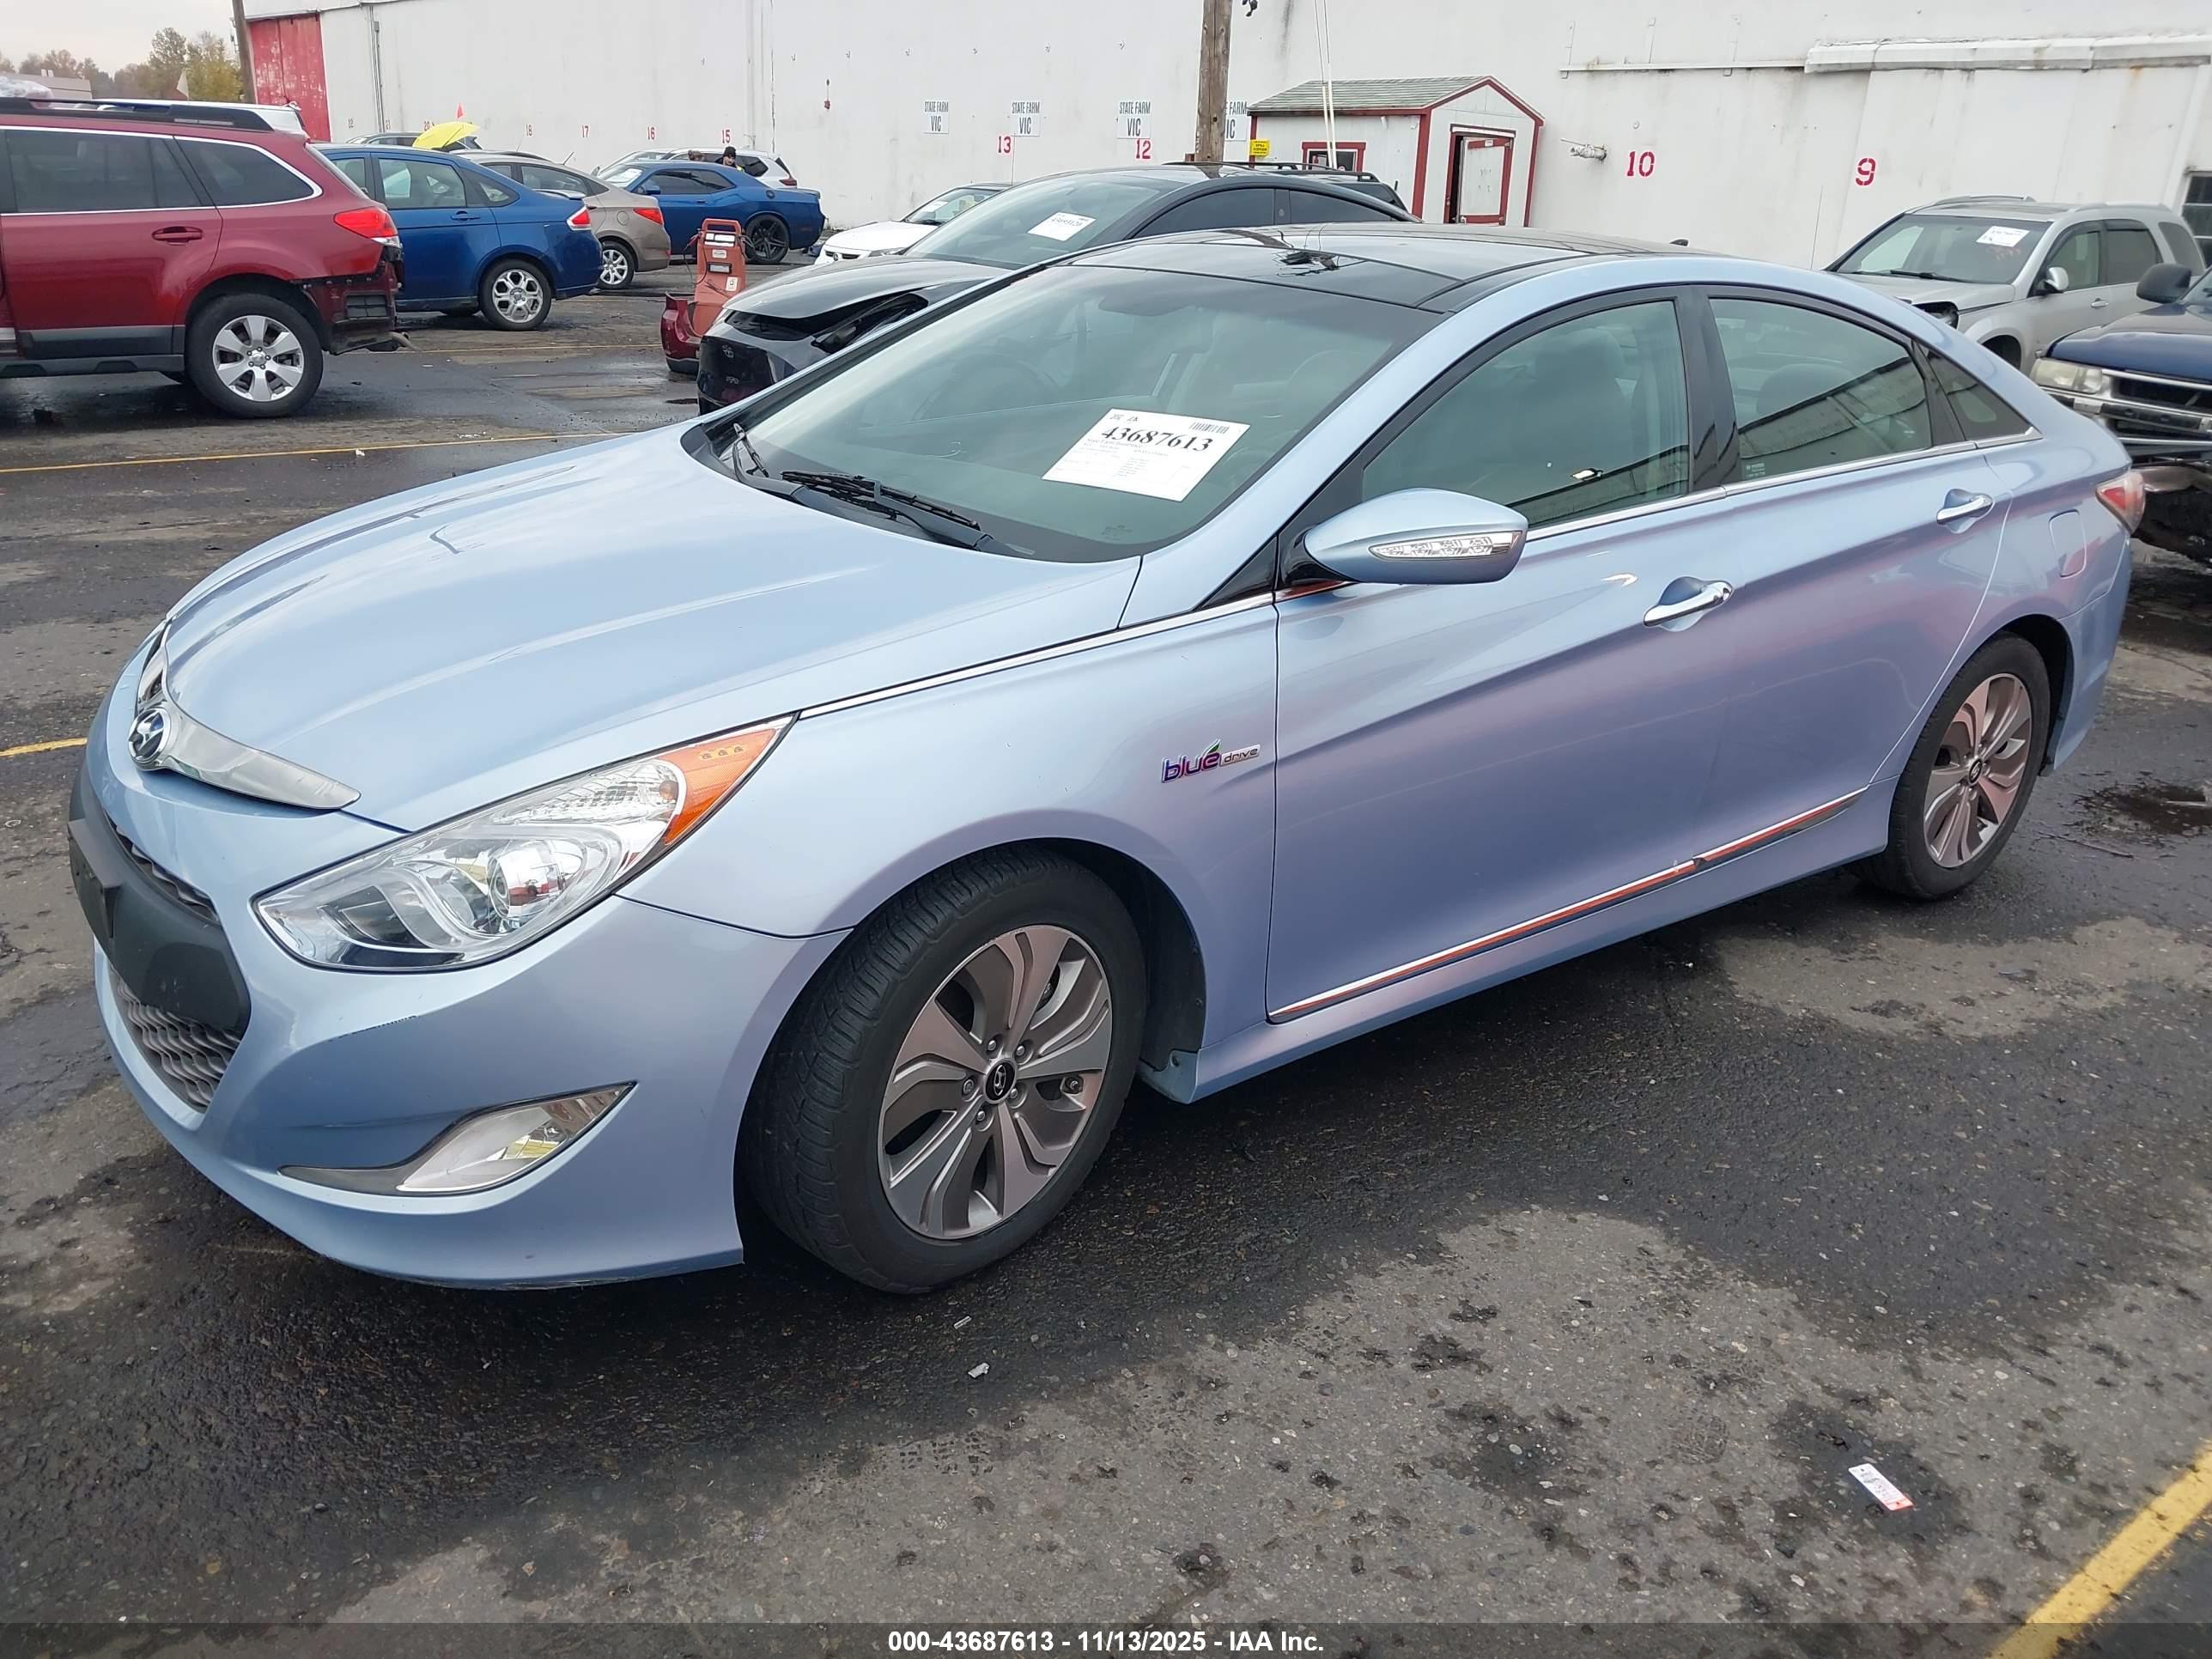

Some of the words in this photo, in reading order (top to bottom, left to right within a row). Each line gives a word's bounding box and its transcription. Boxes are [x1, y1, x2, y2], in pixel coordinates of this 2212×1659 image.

[924, 100, 936, 112] STATE
[937, 100, 949, 112] FARM
[1012, 101, 1026, 113] STATE
[1026, 101, 1041, 114] FARM
[1119, 101, 1134, 114] STATE
[1134, 101, 1151, 114] FARM
[526, 124, 533, 137] 18
[581, 125, 590, 138] 17
[647, 126, 656, 140] 16
[930, 116, 942, 132] VIC
[1018, 117, 1031, 135] VIC
[1127, 118, 1141, 137] VIC
[1225, 118, 1236, 139] IC
[721, 129, 732, 143] 15
[998, 135, 1012, 154] 13
[1135, 139, 1152, 160] 12
[1626, 150, 1656, 178] 10
[1855, 157, 1876, 186] 9
[1101, 426, 1213, 452] 43687613
[1161, 747, 1220, 783] blue
[1223, 747, 1259, 763] drive
